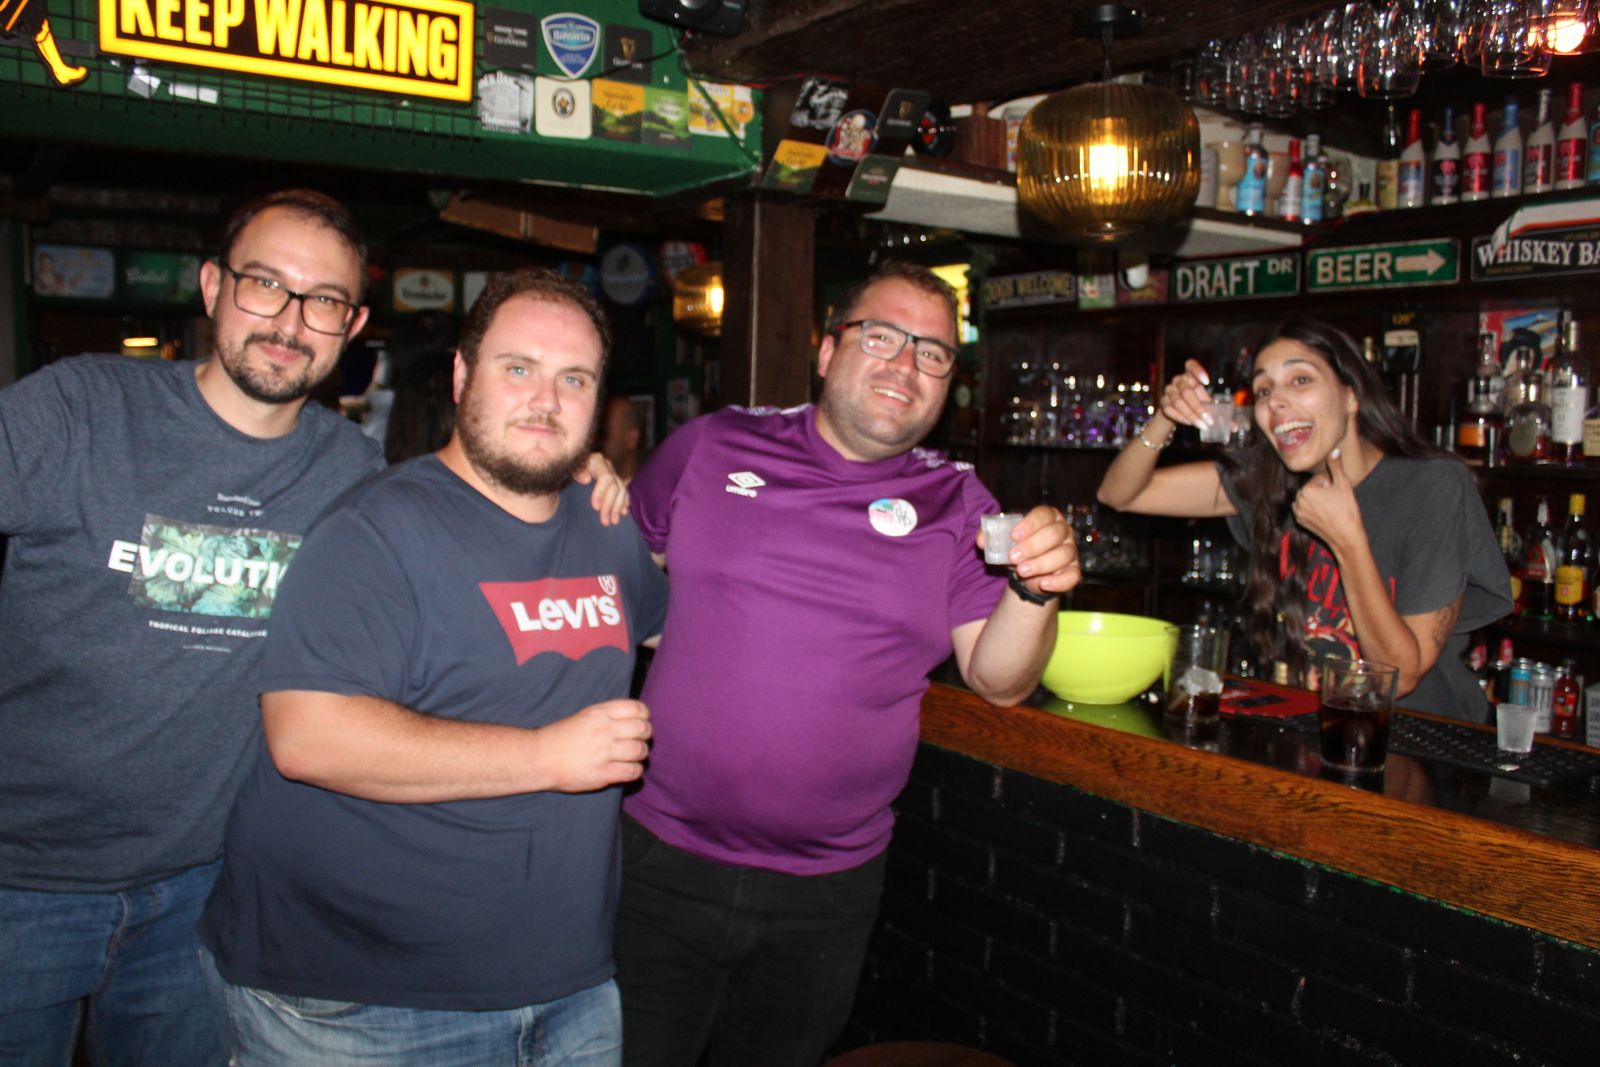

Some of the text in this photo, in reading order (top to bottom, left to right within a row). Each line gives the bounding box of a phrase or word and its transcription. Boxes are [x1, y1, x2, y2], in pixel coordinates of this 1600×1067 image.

[119, 0, 459, 81] KEEP WALKING
[552, 30, 591, 42] Bavaria
[1316, 252, 1393, 285] BEER
[1477, 240, 1574, 268] WHISKEY
[1176, 258, 1293, 300] DRAFT DR
[725, 484, 758, 498] umbro
[107, 540, 288, 589] EVOLUTI
[149, 620, 189, 633] TROPICAL
